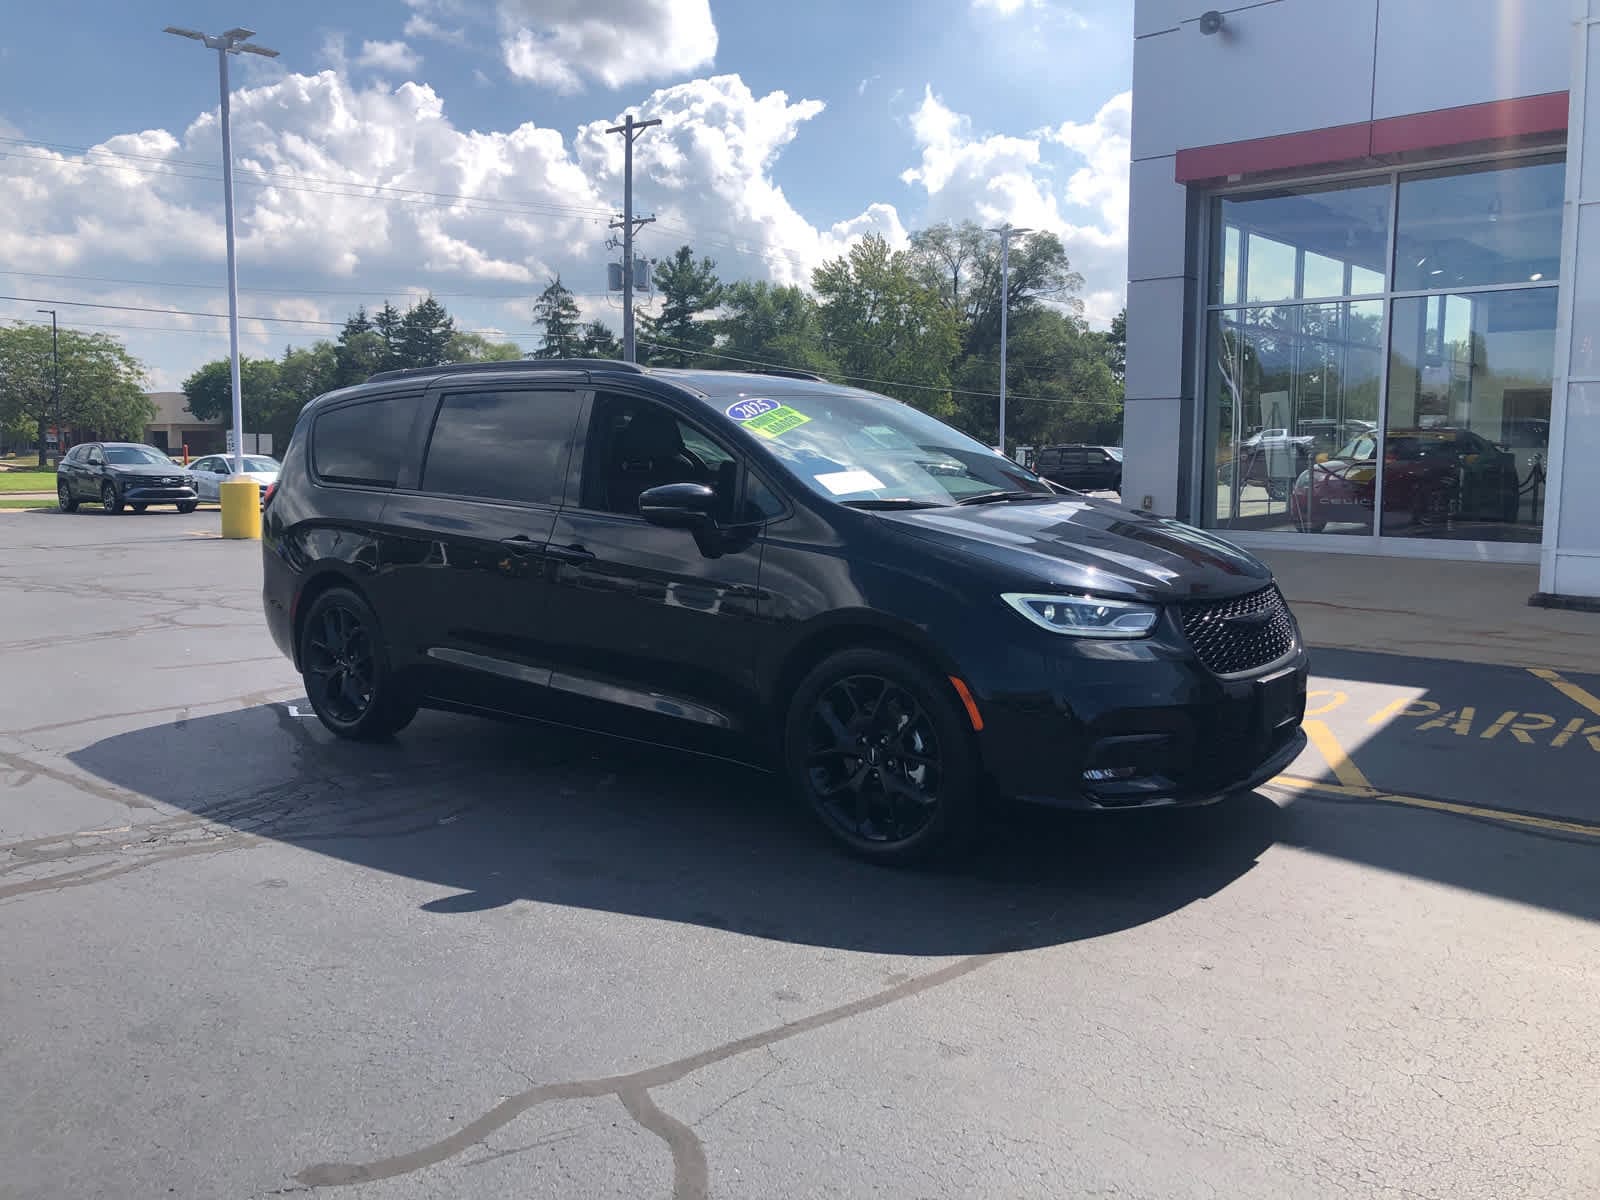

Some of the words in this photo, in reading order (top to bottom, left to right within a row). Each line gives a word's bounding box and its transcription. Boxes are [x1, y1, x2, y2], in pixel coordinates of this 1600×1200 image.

[735, 399, 771, 418] 2025
[1319, 497, 1387, 505] CELIC
[1367, 698, 1600, 753] PARK
